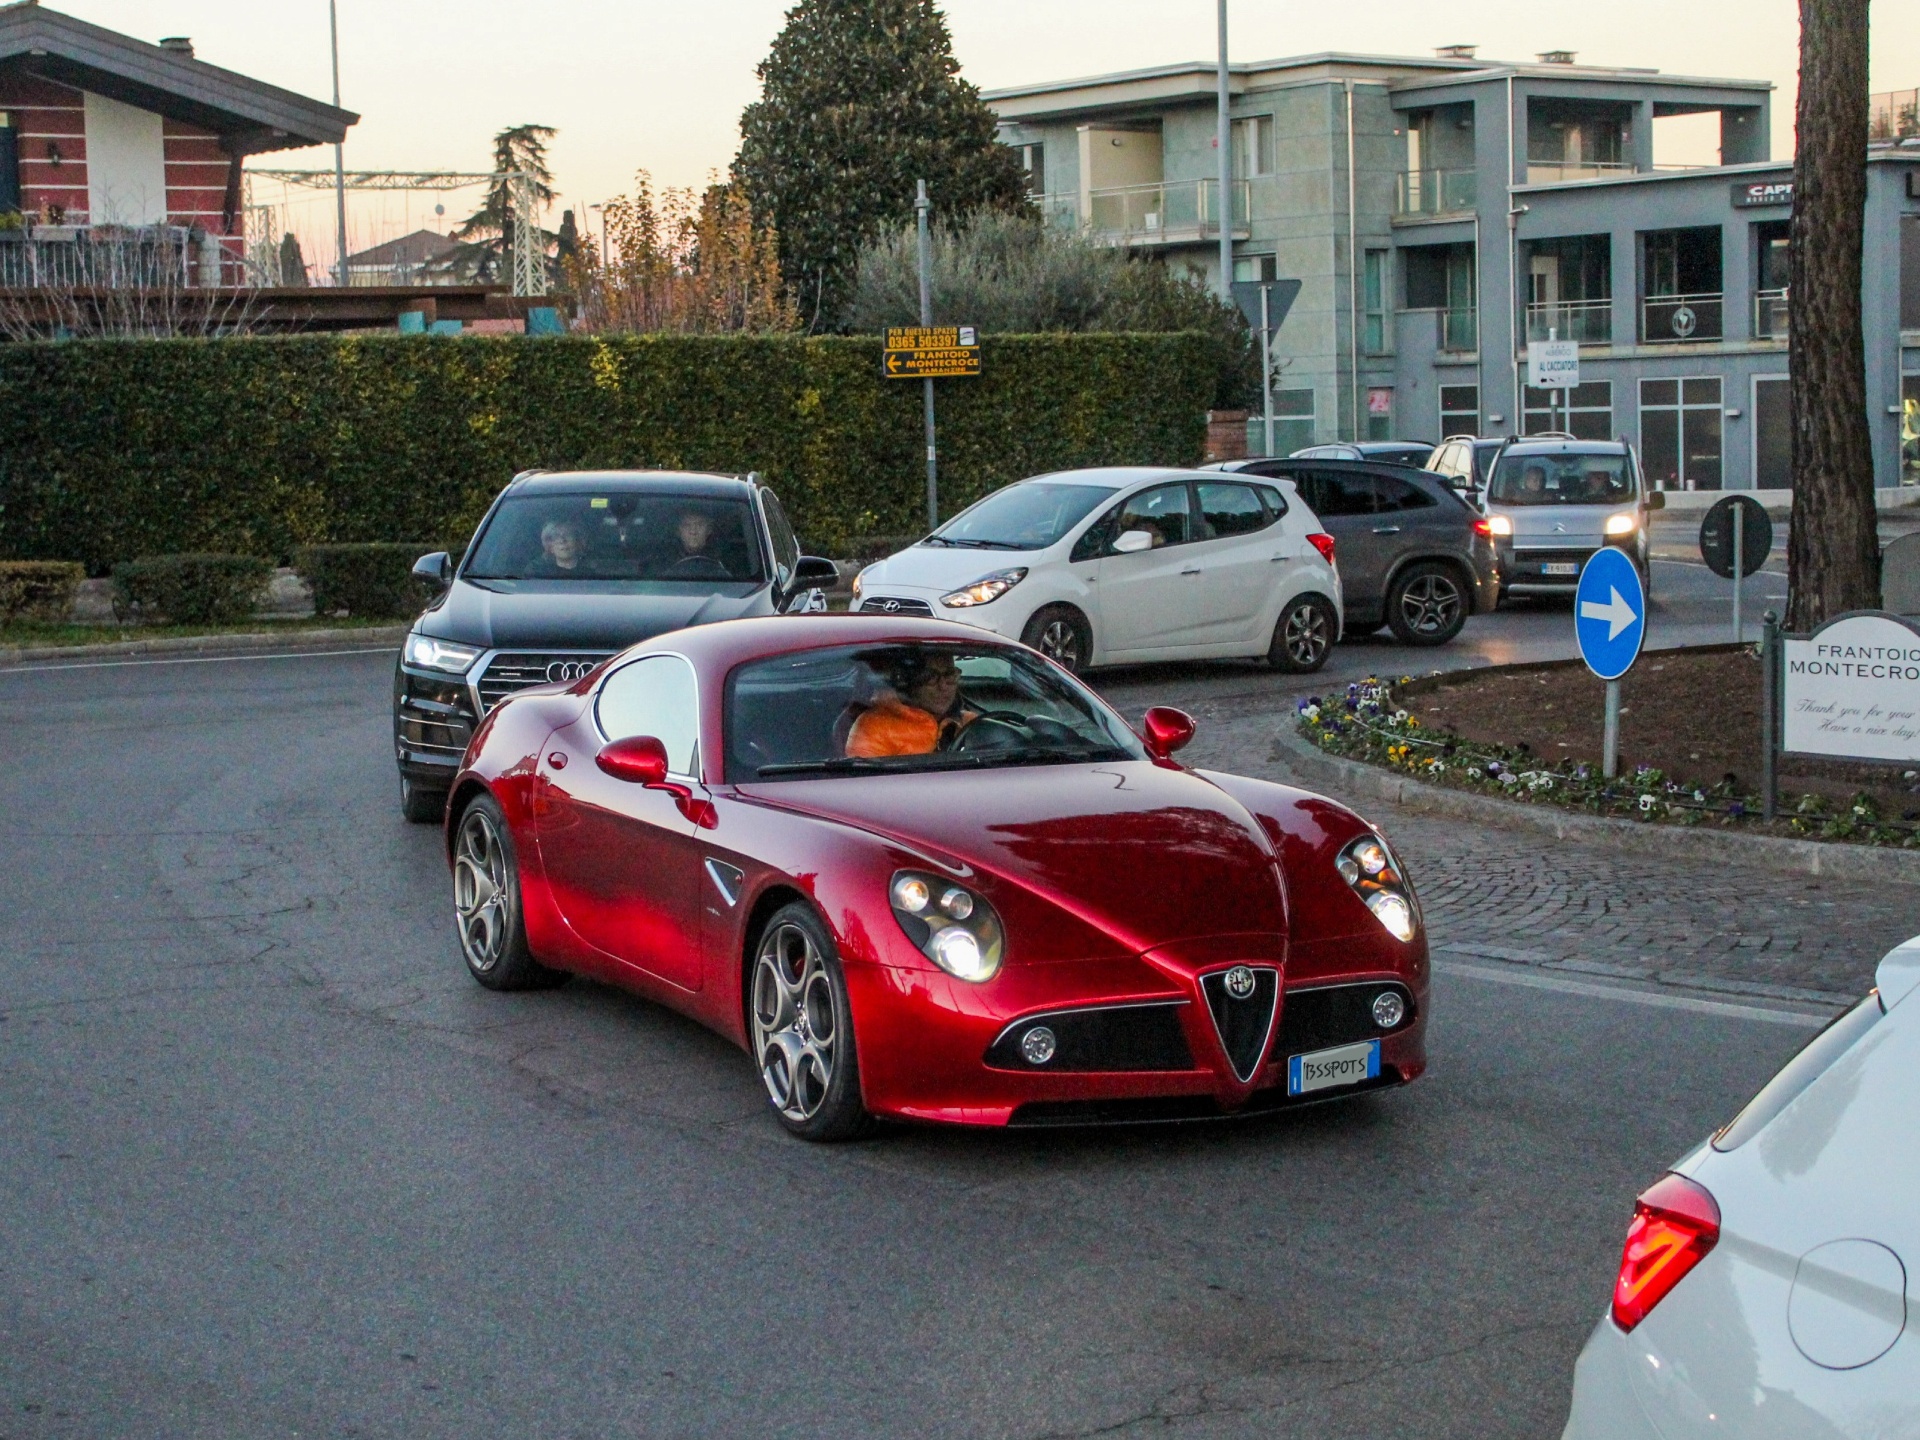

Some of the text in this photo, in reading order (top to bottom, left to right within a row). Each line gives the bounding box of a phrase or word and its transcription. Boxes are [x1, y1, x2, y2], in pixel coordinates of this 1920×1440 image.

[888, 326, 958, 336] PER QUESTO SPAZIO
[888, 335, 957, 348] 0365 503397
[914, 350, 970, 359] FRANTOIO
[906, 358, 979, 368] MONTECROCE
[1540, 360, 1578, 372] AL CACCIATORE
[1818, 644, 1920, 662] FRANTOIO
[1794, 699, 1916, 721] Thank you for your
[1818, 719, 1847, 733] Have
[1865, 726, 1888, 736] nice
[1892, 725, 1920, 741] day!
